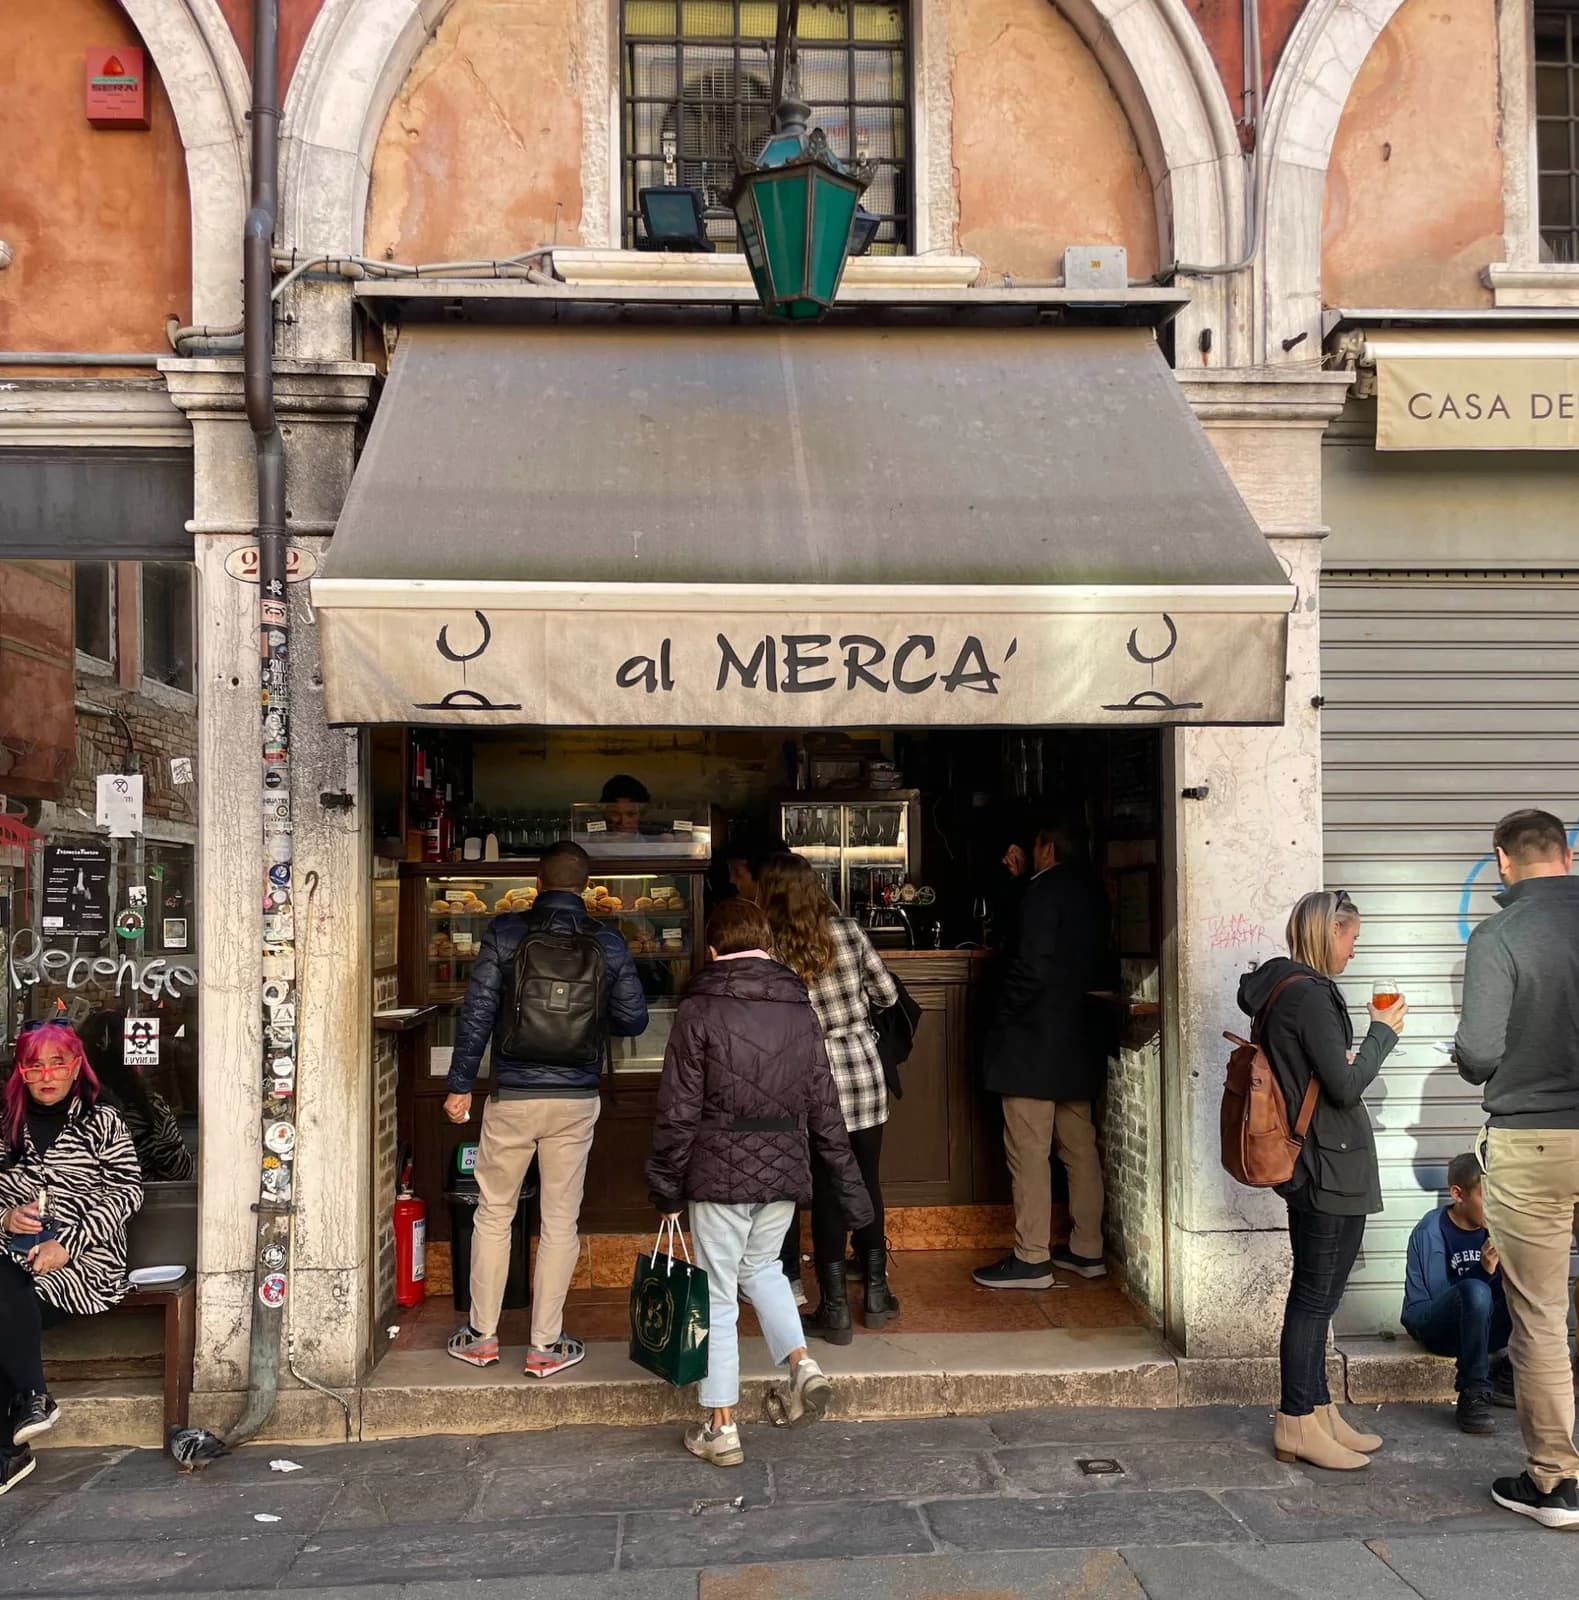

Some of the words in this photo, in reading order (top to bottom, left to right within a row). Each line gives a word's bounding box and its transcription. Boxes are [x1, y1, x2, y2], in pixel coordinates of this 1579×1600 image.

[1408, 392, 1511, 420] CASA
[1531, 393, 1579, 419] DE
[241, 551, 300, 575] 22
[615, 638, 675, 694] al
[1450, 1249, 1482, 1269] WEEKE
